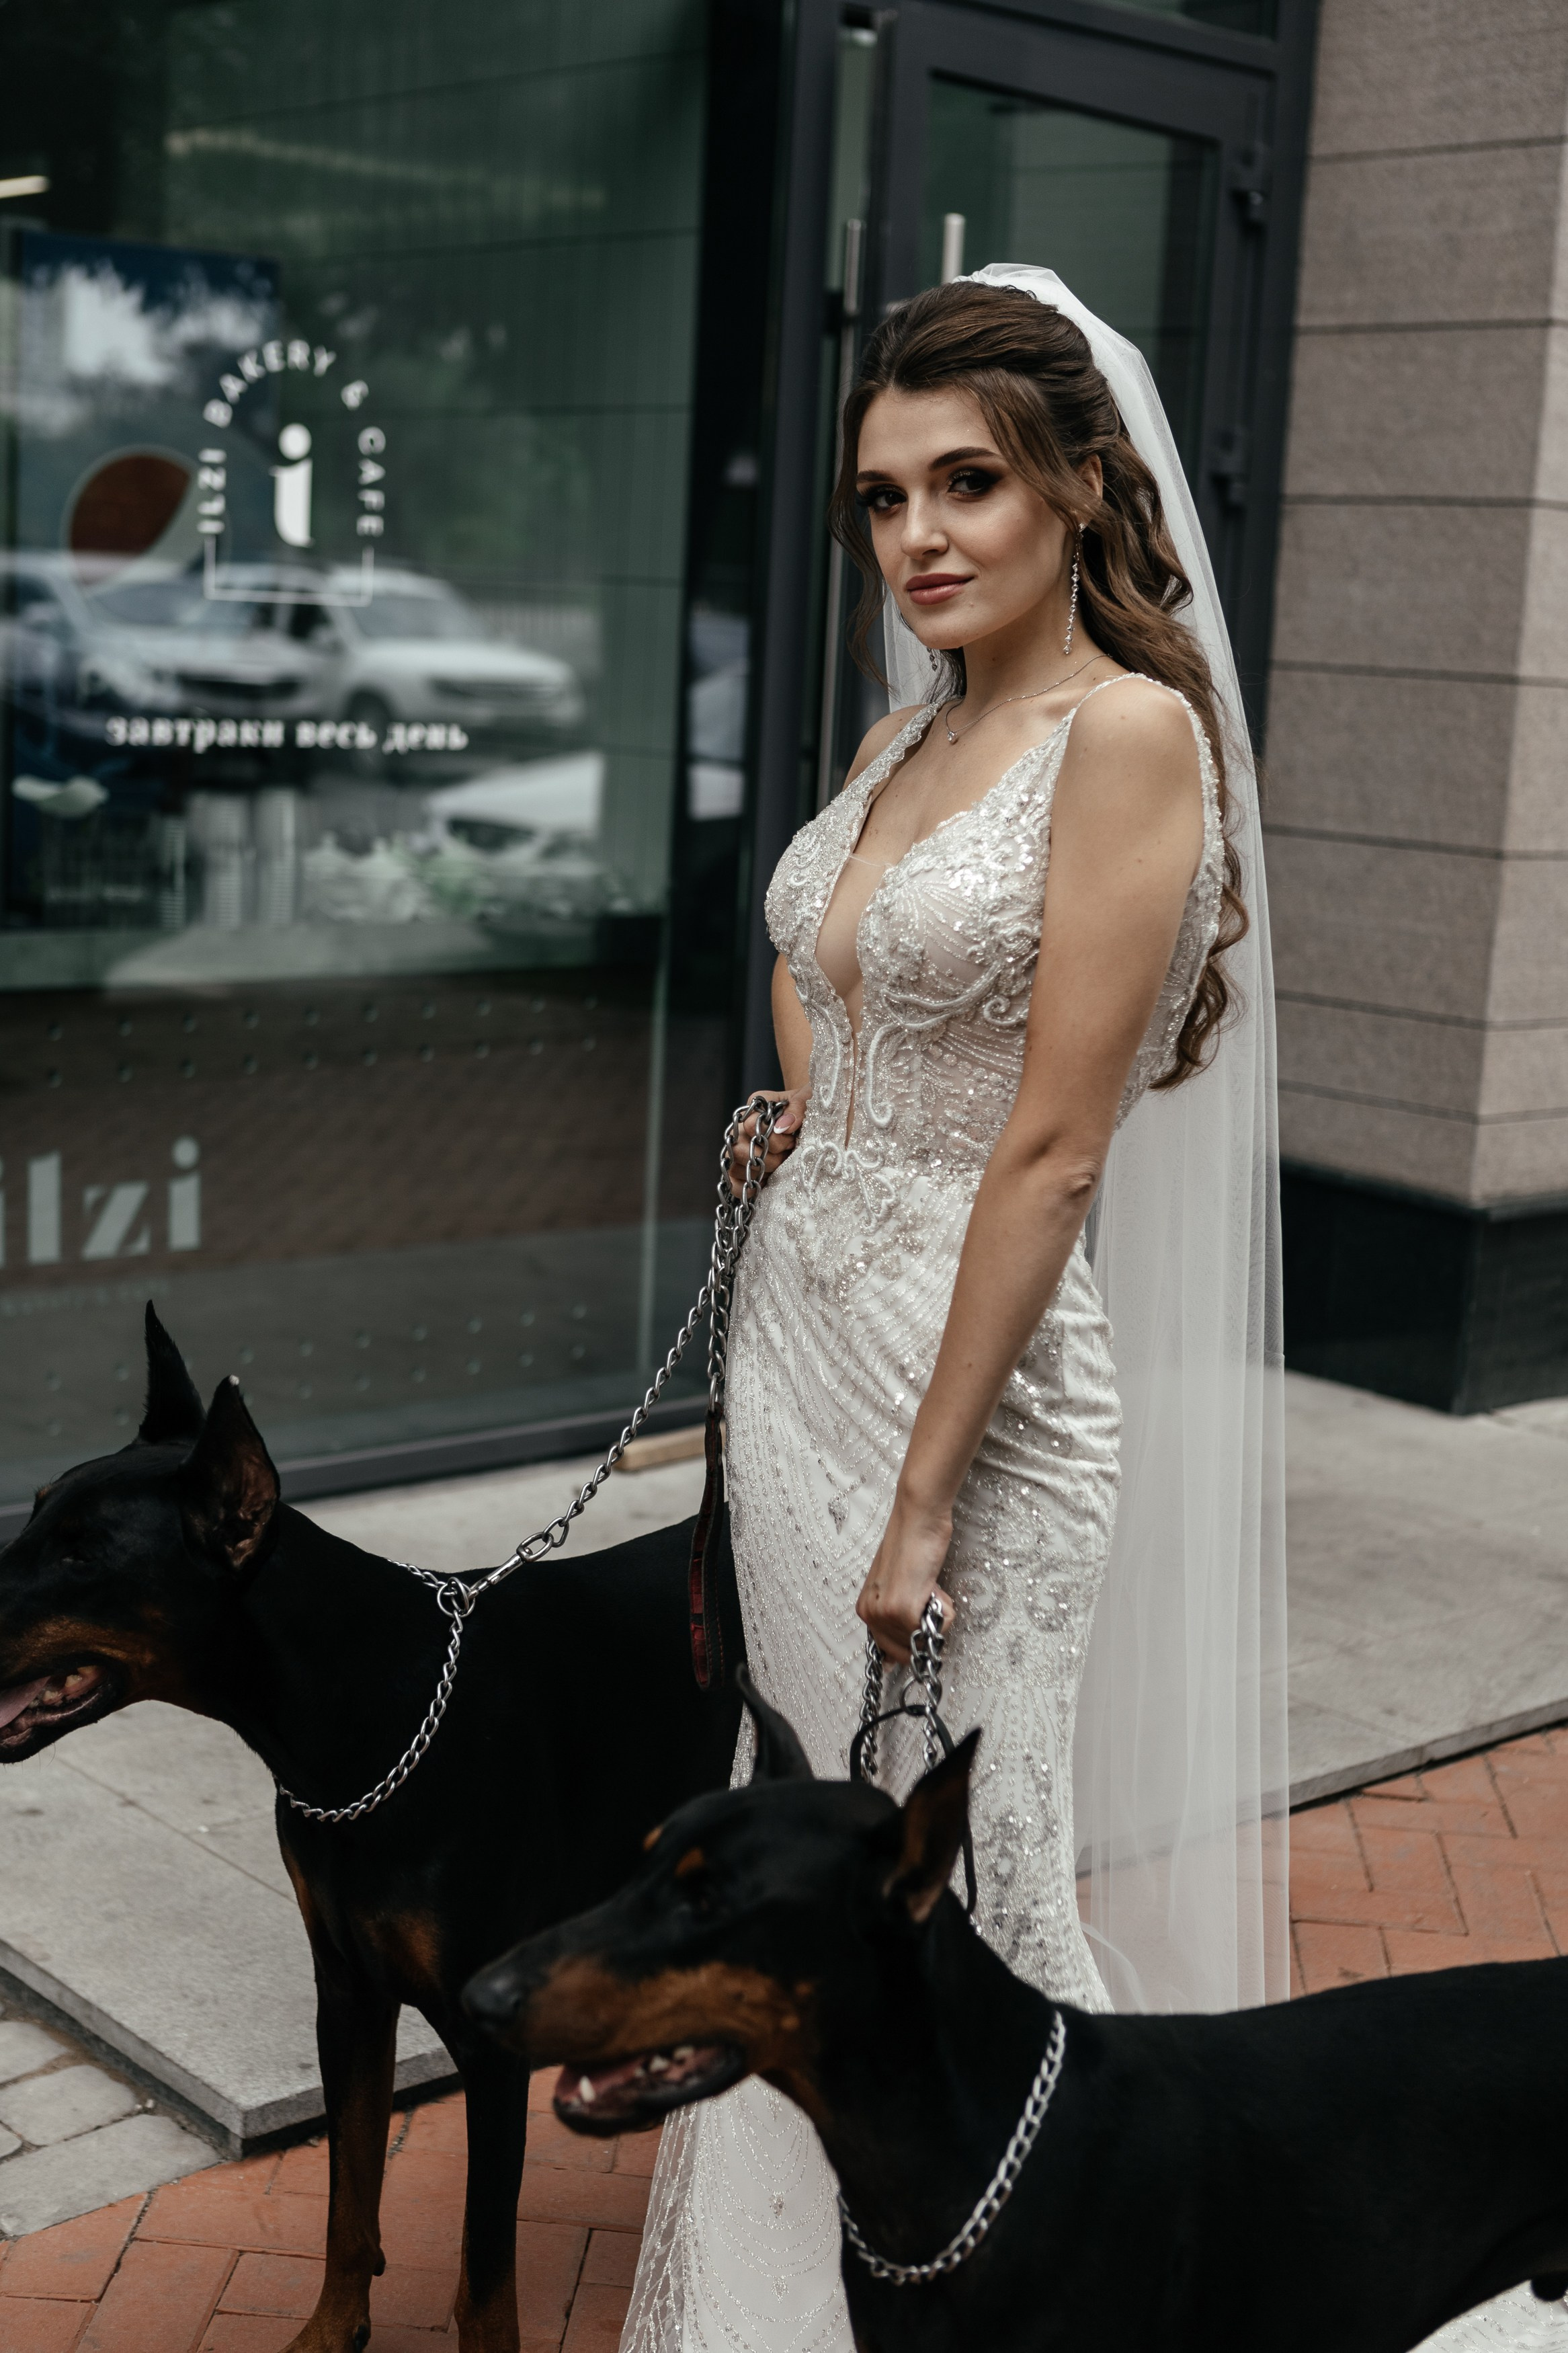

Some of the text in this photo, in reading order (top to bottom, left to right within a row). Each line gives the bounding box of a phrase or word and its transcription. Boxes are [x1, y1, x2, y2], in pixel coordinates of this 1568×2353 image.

[202, 339, 337, 428] BAKERY
[356, 426, 386, 536] CAFE
[106, 717, 468, 755] завтраки весь день
[0, 1135, 201, 1270] lzi
